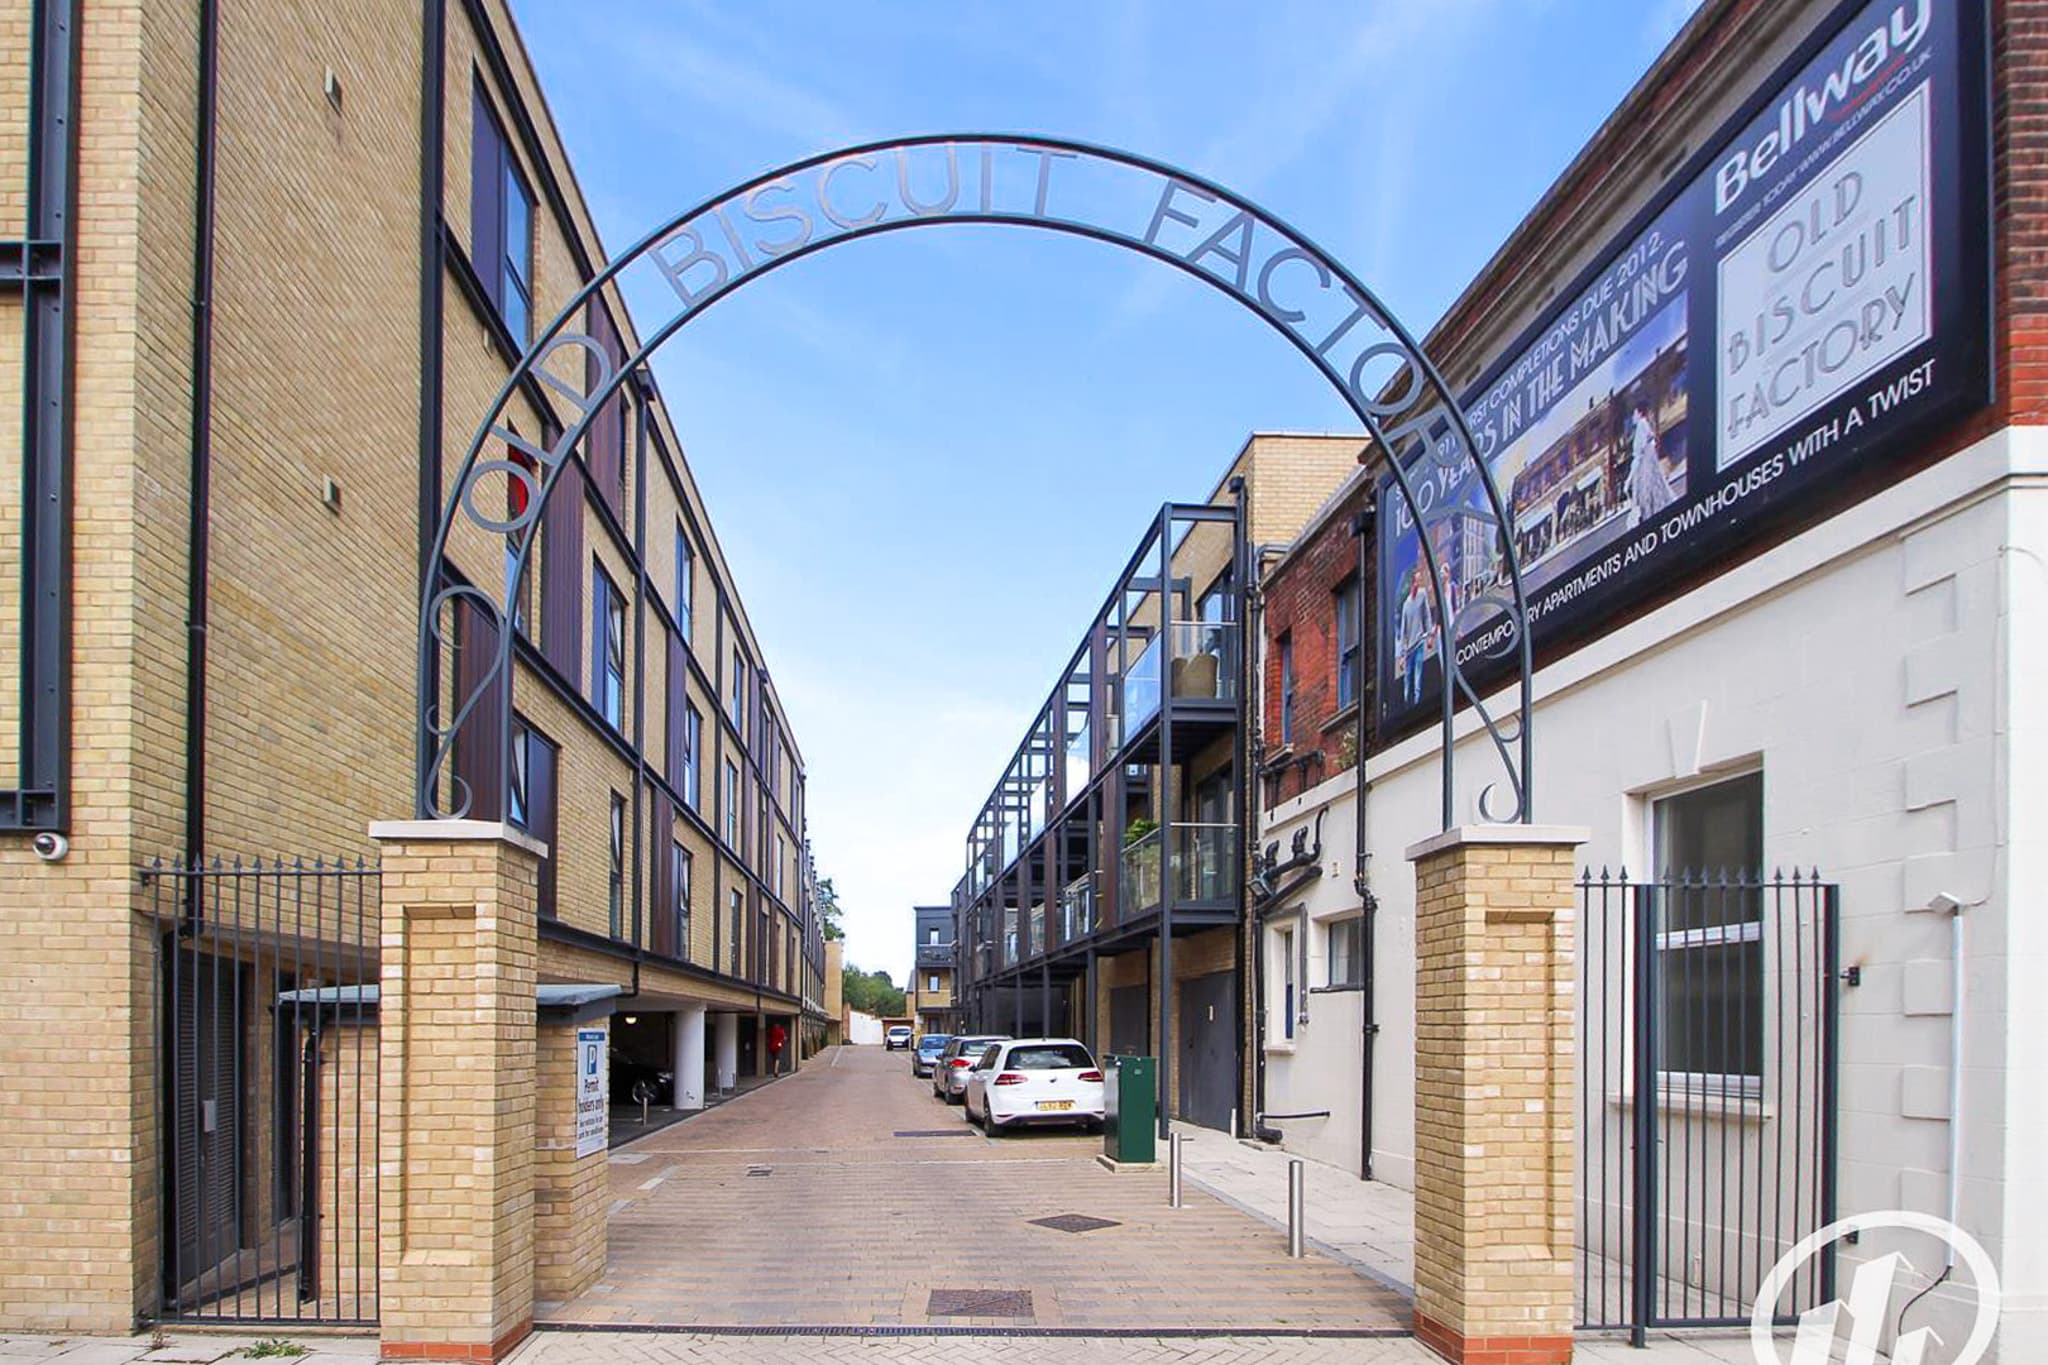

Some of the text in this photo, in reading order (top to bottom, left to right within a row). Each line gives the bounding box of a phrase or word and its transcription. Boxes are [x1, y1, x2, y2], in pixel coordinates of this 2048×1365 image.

[1715, 0, 1931, 217] Bellway
[1728, 194, 1916, 376] BISCUIT
[1767, 171, 1863, 273] OLD
[461, 139, 1499, 534] OLD BISCUIT FACTORY
[1489, 311, 1580, 408] COMPLETIONS
[1583, 278, 1613, 321] DUE
[1617, 231, 1665, 288] 2012.
[1502, 394, 1522, 442] IN
[1527, 352, 1565, 418] THE
[1569, 240, 1690, 381] MAKING
[1727, 272, 1916, 438] FACTORY
[1455, 358, 1937, 666] CONTEMPORY APARTMENTS AND TOWNHOUSES WITH A TWIST
